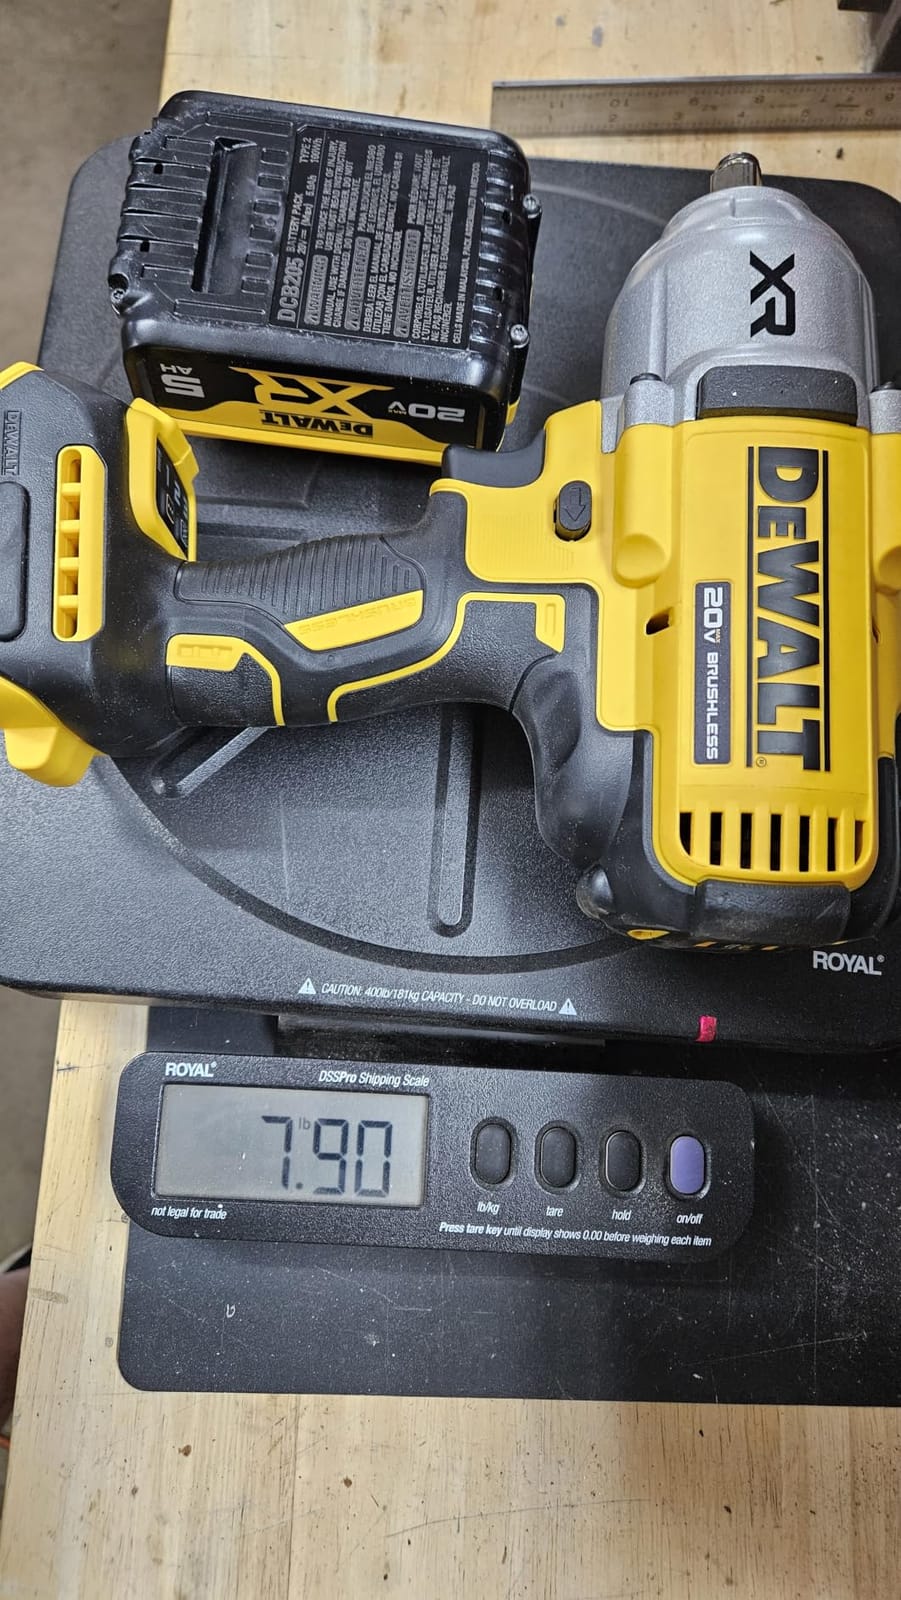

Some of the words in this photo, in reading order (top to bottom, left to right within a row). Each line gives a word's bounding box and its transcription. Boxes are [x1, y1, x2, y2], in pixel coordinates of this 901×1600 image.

[299, 144, 311, 164] TYPE
[310, 137, 322, 163] 100Wh
[343, 160, 353, 176] NOT
[305, 174, 317, 197] 5.0Ah
[323, 178, 333, 195] RISK
[291, 192, 304, 216] PACK
[321, 195, 331, 210] THE
[330, 189, 340, 209] READ
[286, 216, 300, 253] BATTERY
[317, 210, 329, 239] REDUCE
[330, 255, 341, 276] WITH
[370, 241, 382, 273] MANUAL
[308, 256, 326, 311] WARNING
[328, 275, 338, 291] USE
[333, 297, 345, 328] CHARGE
[345, 222, 355, 237] NOT
[397, 230, 418, 322] AVERTISSEMENT
[277, 256, 304, 322] DCB205
[367, 284, 377, 302] LEER
[376, 283, 387, 300] CON
[750, 251, 796, 338] XR
[361, 302, 374, 332] DEBERÁ
[372, 300, 384, 333] UTILIZAR
[455, 301, 466, 323] MADE
[382, 313, 393, 335] TIENE
[453, 323, 463, 344] CELLS
[160, 362, 193, 375] AH
[161, 374, 204, 399] 5
[228, 366, 394, 417] XR
[260, 410, 374, 438] DEWALT
[4, 411, 20, 475] DEWALT
[757, 446, 820, 770] DEWALT
[704, 652, 720, 760] BRUSHLESS
[813, 951, 876, 976] ROYAL
[321, 983, 362, 996] CAUTION:
[365, 985, 420, 1002] 400lb/181kg
[421, 990, 464, 1003] CAPACITY
[472, 994, 487, 1005] DO
[488, 995, 507, 1007] NOT
[509, 997, 557, 1011] OVERLOAD
[165, 1063, 214, 1078] ROYAL
[319, 1070, 357, 1084] DSSPro
[358, 1073, 401, 1087] Shipping
[403, 1075, 430, 1088] Scale
[298, 1117, 310, 1130] lb
[261, 1115, 393, 1196] 7.90
[151, 1206, 165, 1218] not
[166, 1207, 189, 1220] legal
[190, 1207, 203, 1219] for
[203, 1209, 227, 1220] trade
[477, 1201, 499, 1216] lb/kg
[546, 1206, 563, 1217] tare
[612, 1209, 631, 1221] hold
[676, 1213, 703, 1225] on/off
[439, 1222, 465, 1234] Press
[466, 1224, 485, 1234] tare
[486, 1224, 503, 1237] key
[504, 1226, 522, 1236] until
[523, 1226, 553, 1240] display
[554, 1229, 581, 1239] shows
[583, 1229, 602, 1240] 0.00
[604, 1231, 631, 1242] before
[632, 1233, 670, 1246] weighing
[671, 1235, 692, 1245] each
[693, 1236, 712, 1246] item
